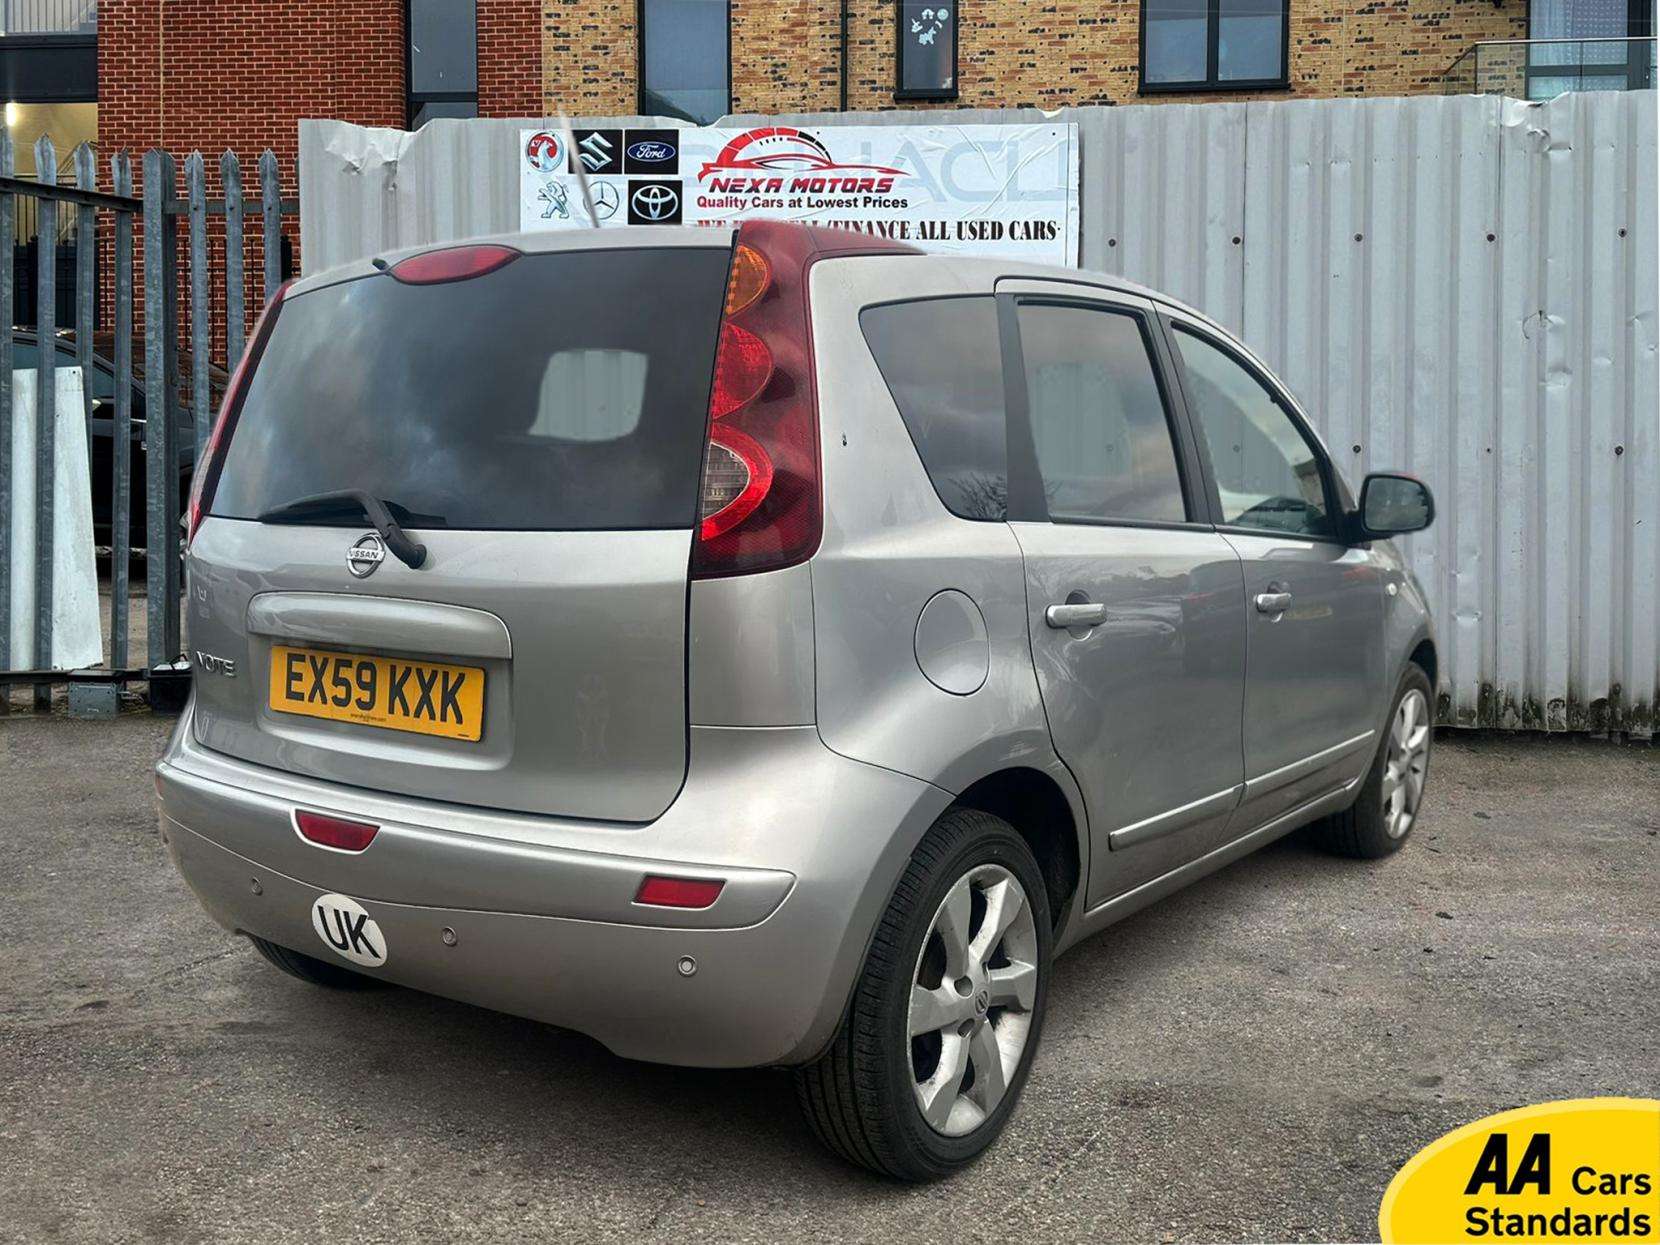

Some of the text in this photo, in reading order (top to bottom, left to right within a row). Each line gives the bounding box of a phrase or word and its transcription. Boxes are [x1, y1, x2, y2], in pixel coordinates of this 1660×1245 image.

[636, 144, 666, 158] Ford
[709, 178, 895, 194] NEXA MOTORS
[697, 196, 908, 210] Quality Cars at Lowest Prices
[916, 220, 950, 240] ALL
[956, 220, 1004, 240] USED
[1009, 220, 1057, 240] CARS
[285, 652, 467, 725] EX59 KXK
[317, 905, 381, 959] UK
